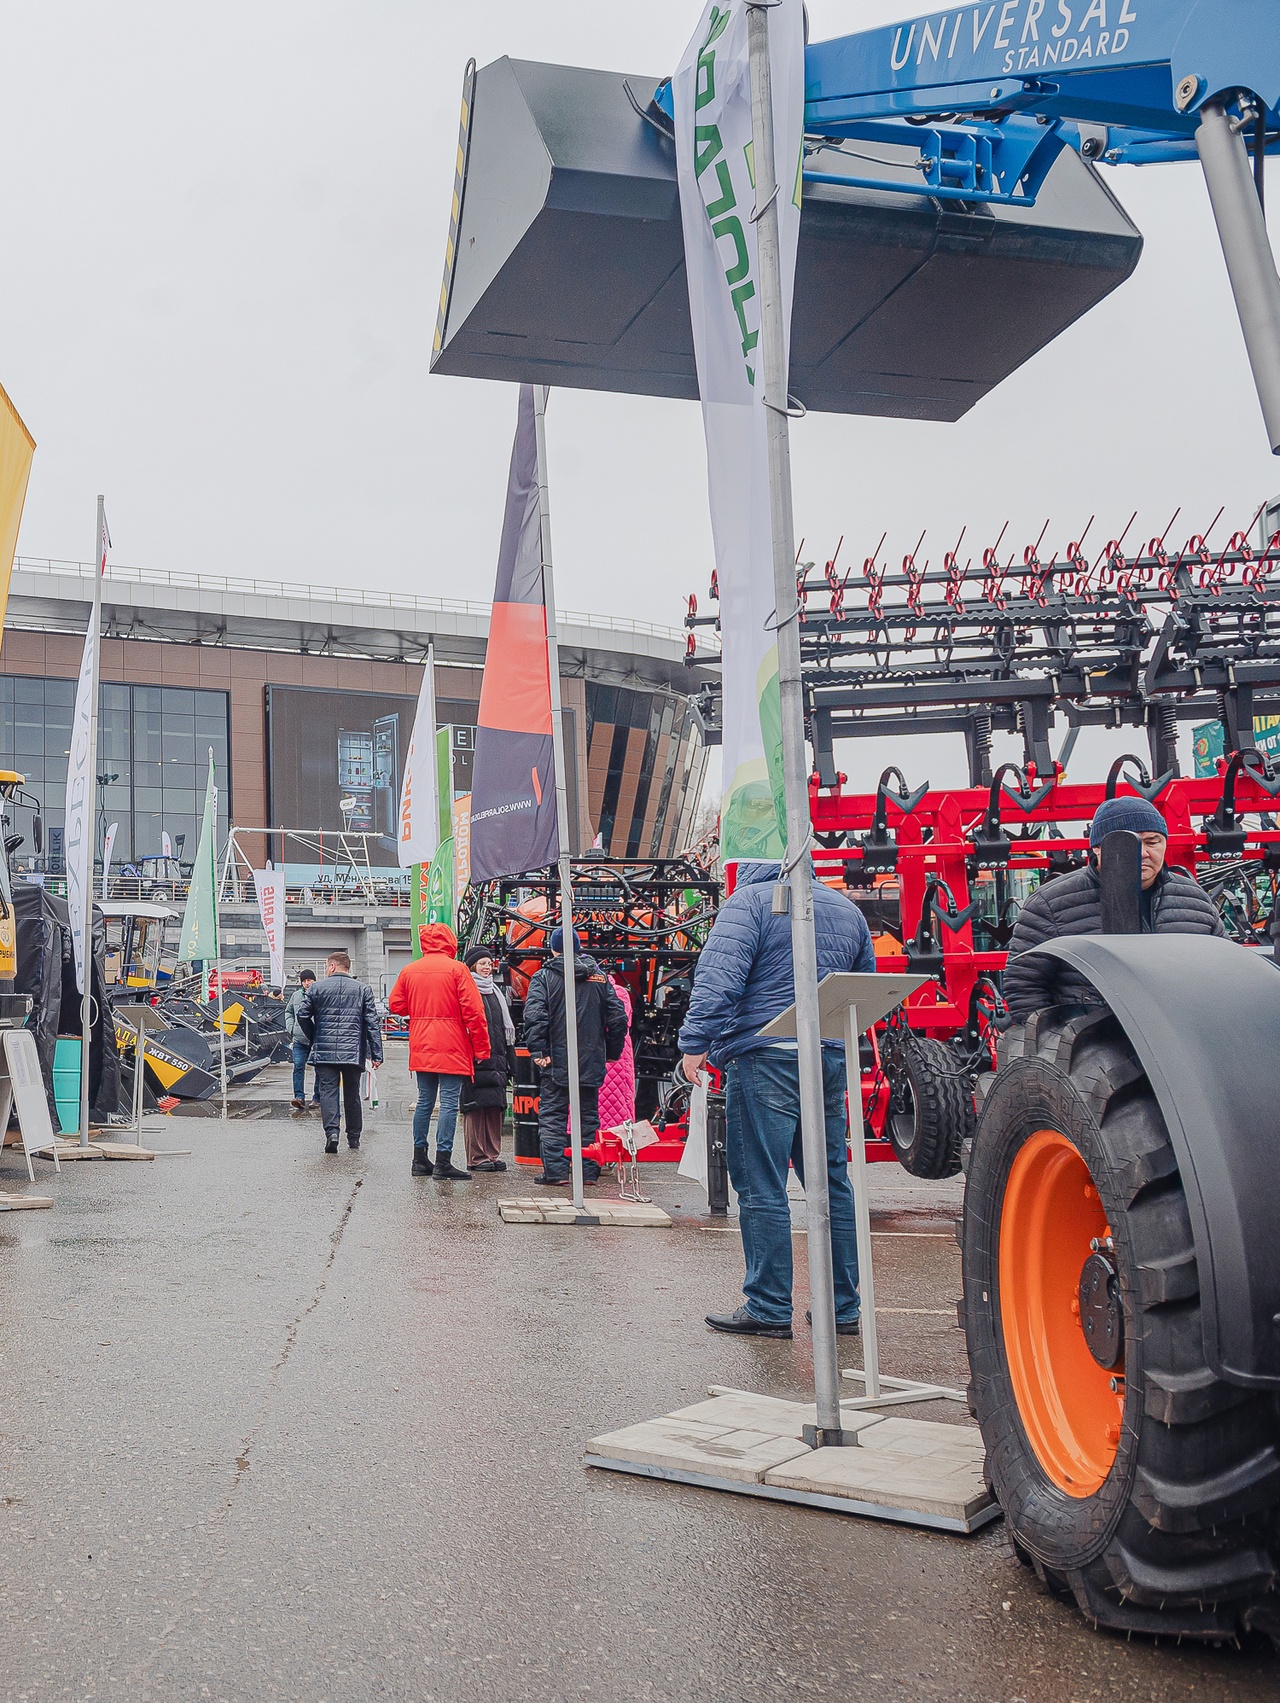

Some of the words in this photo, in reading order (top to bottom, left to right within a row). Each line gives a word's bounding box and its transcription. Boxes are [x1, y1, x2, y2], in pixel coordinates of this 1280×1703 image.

[1002, 28, 1130, 73] STANDARD
[147, 1047, 171, 1061] ЖВТ
[170, 1058, 189, 1071] 550
